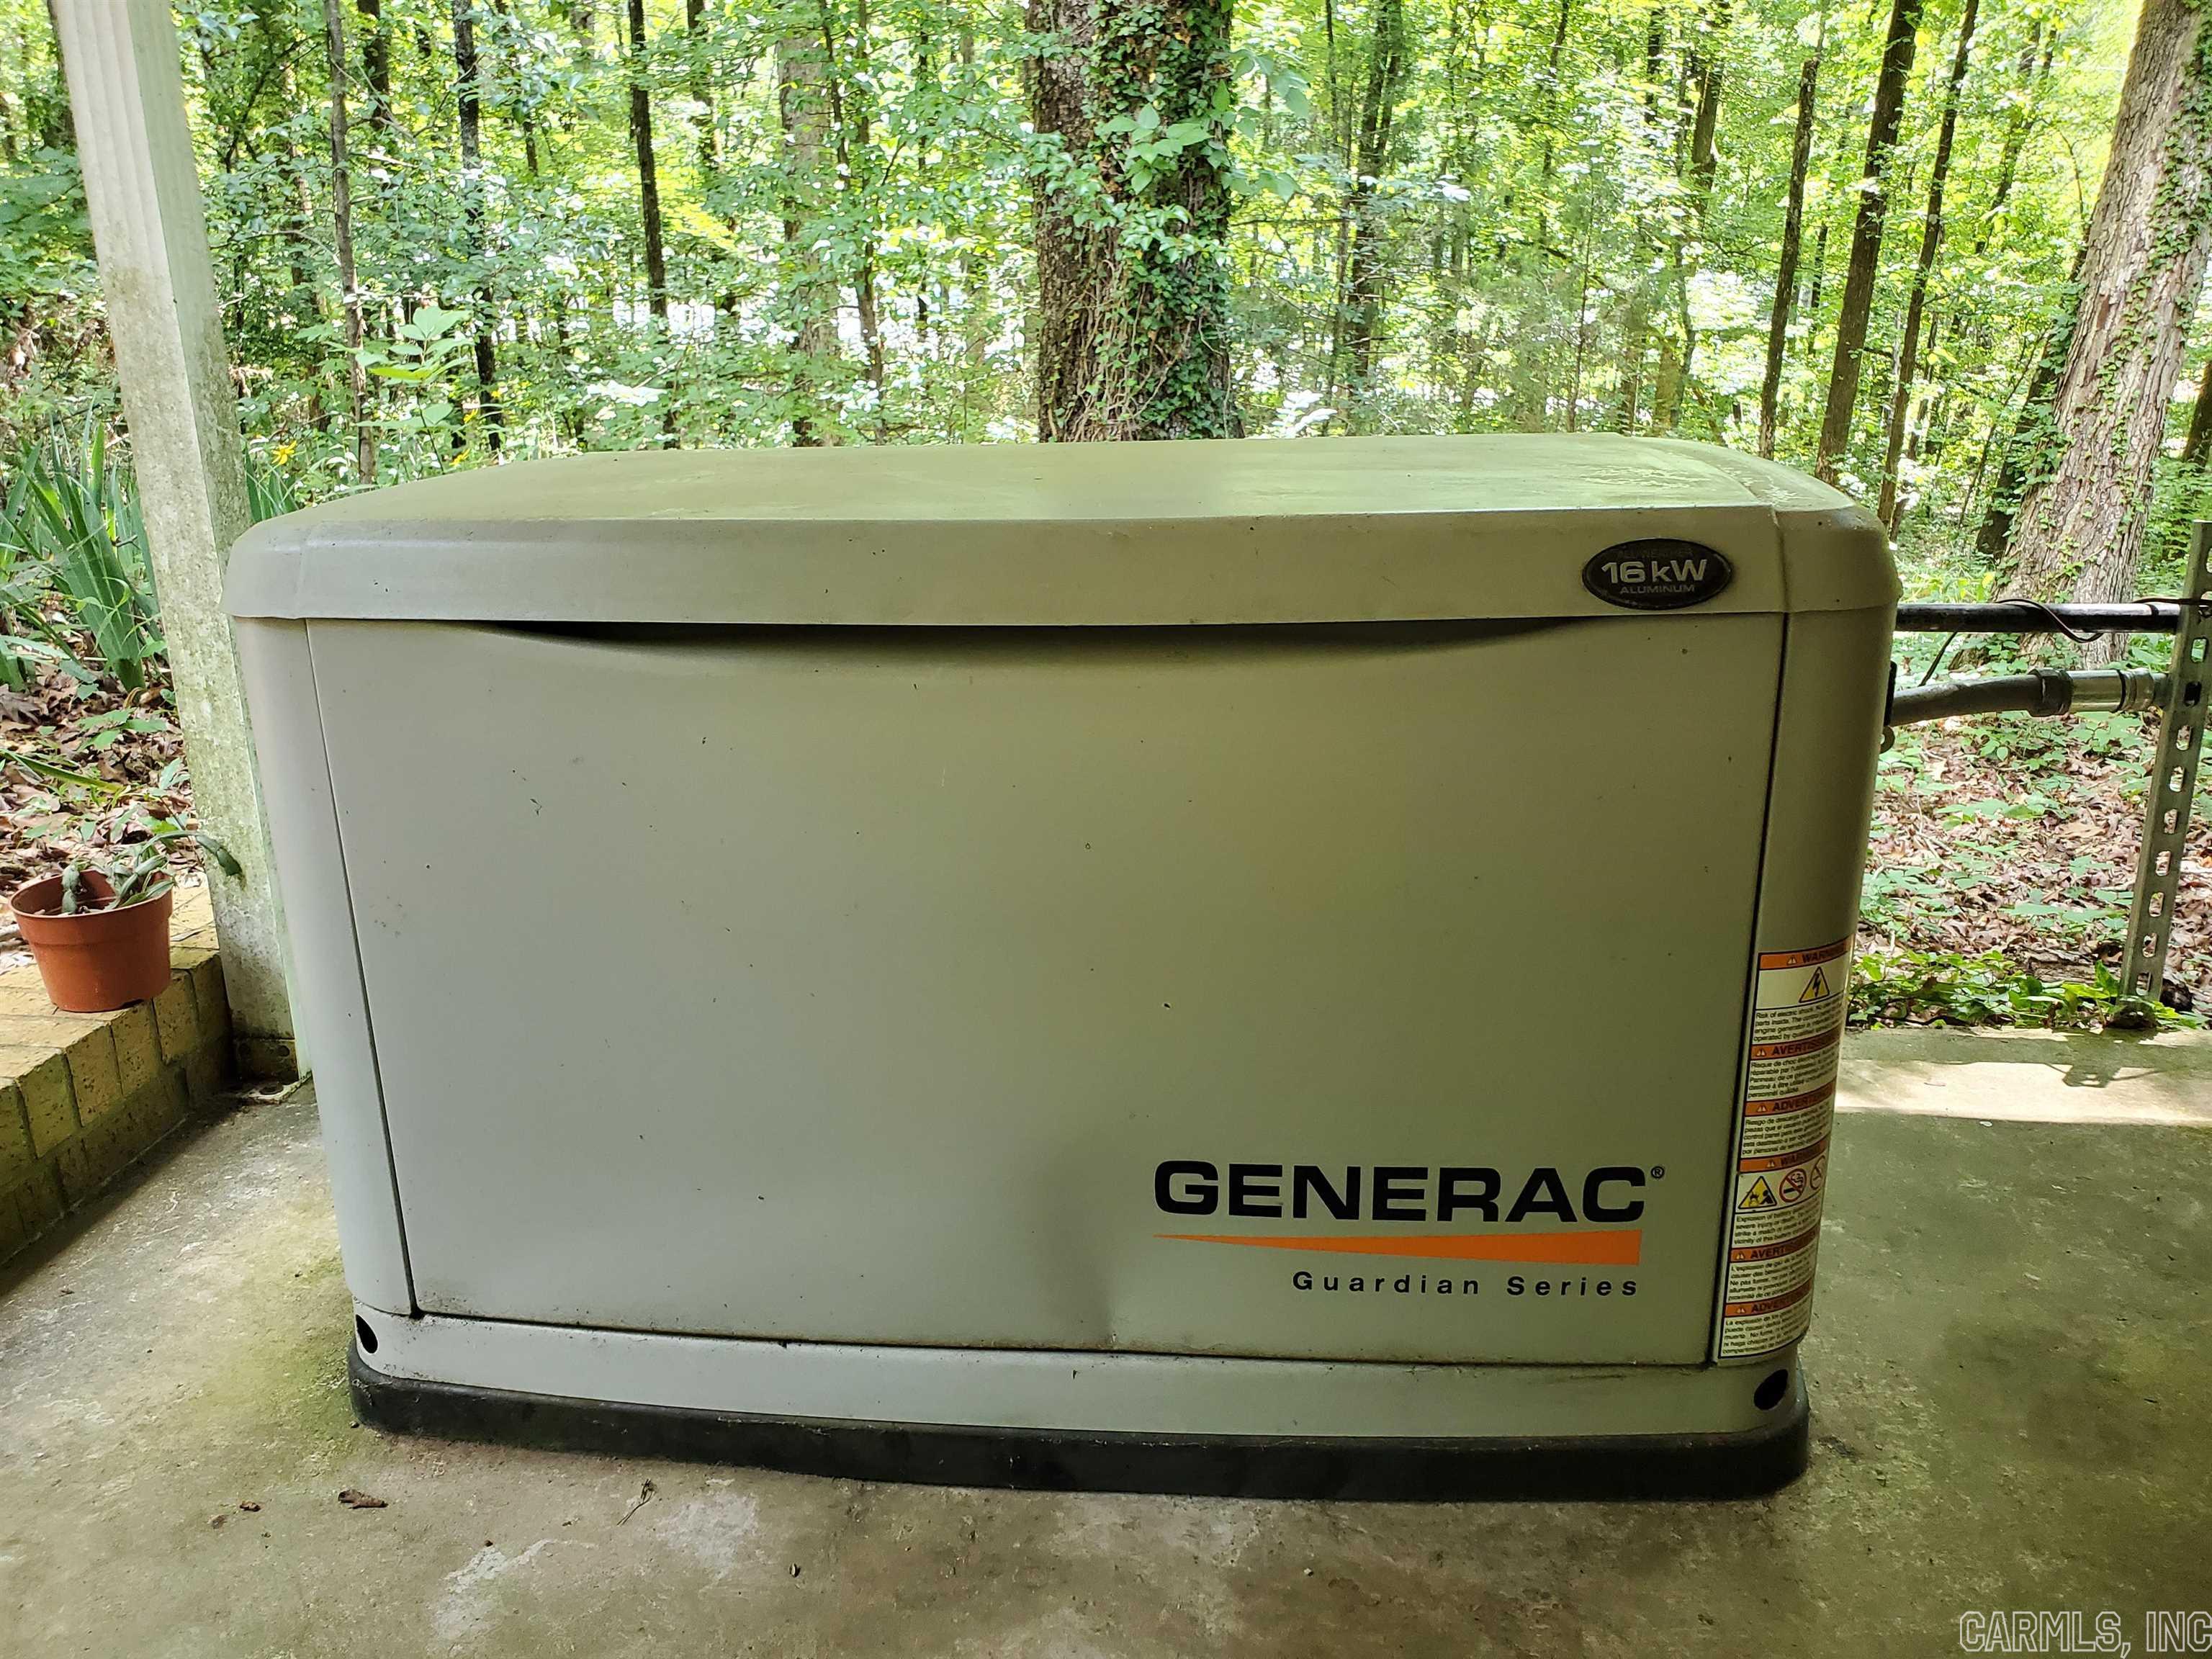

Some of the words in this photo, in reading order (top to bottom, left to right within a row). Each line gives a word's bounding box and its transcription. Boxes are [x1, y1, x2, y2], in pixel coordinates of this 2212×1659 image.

[1620, 584, 1695, 595] ALUMINUM
[1292, 1271, 1480, 1295] Guardian
[1506, 1275, 1638, 1297] Series
